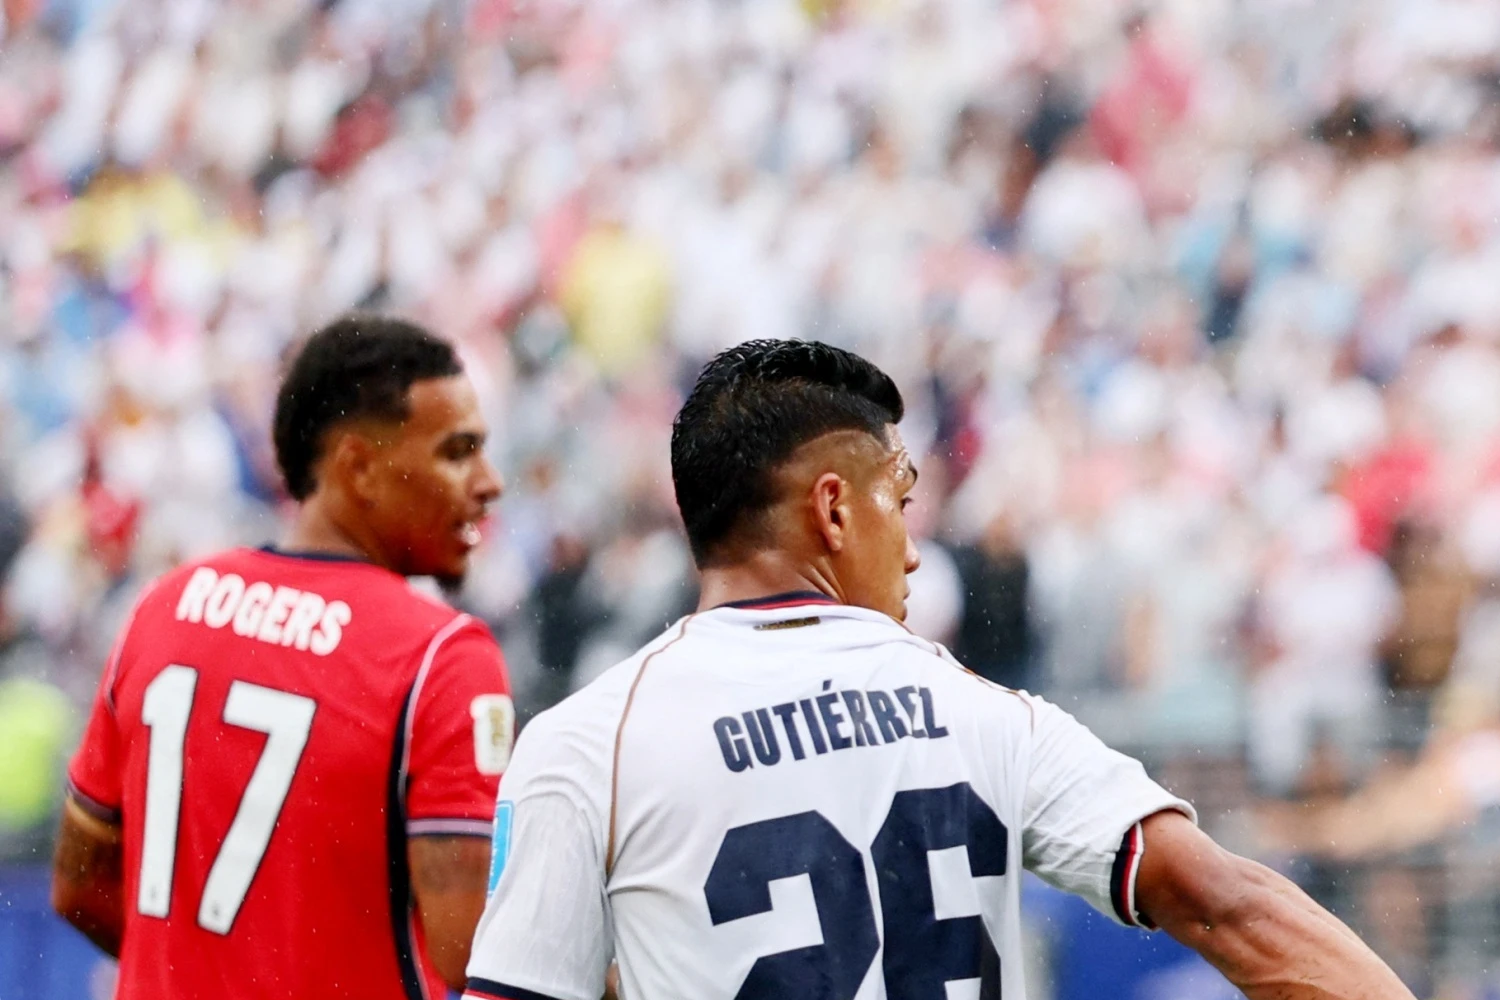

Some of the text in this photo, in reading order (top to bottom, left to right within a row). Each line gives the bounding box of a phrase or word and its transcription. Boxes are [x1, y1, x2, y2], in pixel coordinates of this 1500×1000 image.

[176, 567, 352, 656] ROGERS
[713, 680, 949, 773] GUTIÉRREZ
[138, 663, 317, 936] 17
